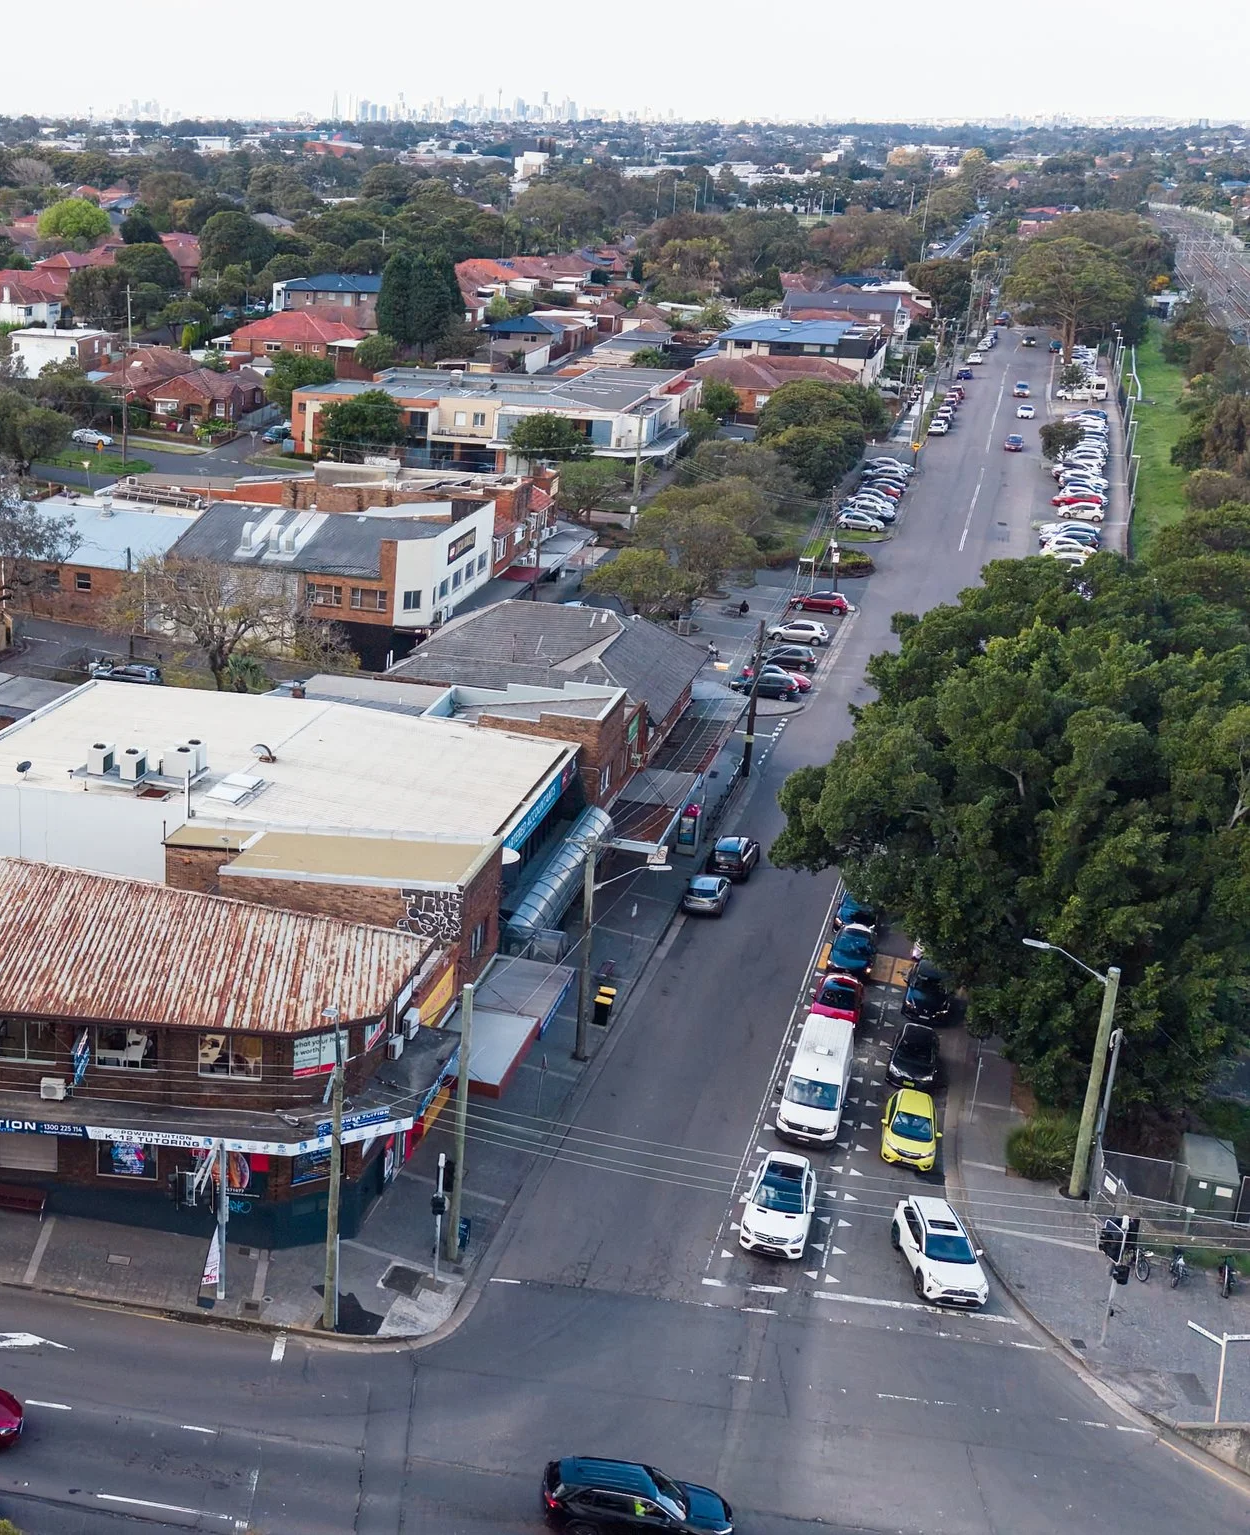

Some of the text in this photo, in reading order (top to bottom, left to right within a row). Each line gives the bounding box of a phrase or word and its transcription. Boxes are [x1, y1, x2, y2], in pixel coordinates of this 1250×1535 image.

[311, 1037, 328, 1048] your
[362, 1109, 390, 1120] TUITION
[43, 1123, 59, 1132] 1300
[59, 1124, 72, 1132] 225
[105, 1133, 200, 1148] K-12 TUTORING
[113, 1129, 192, 1141] MPOWER TUITION
